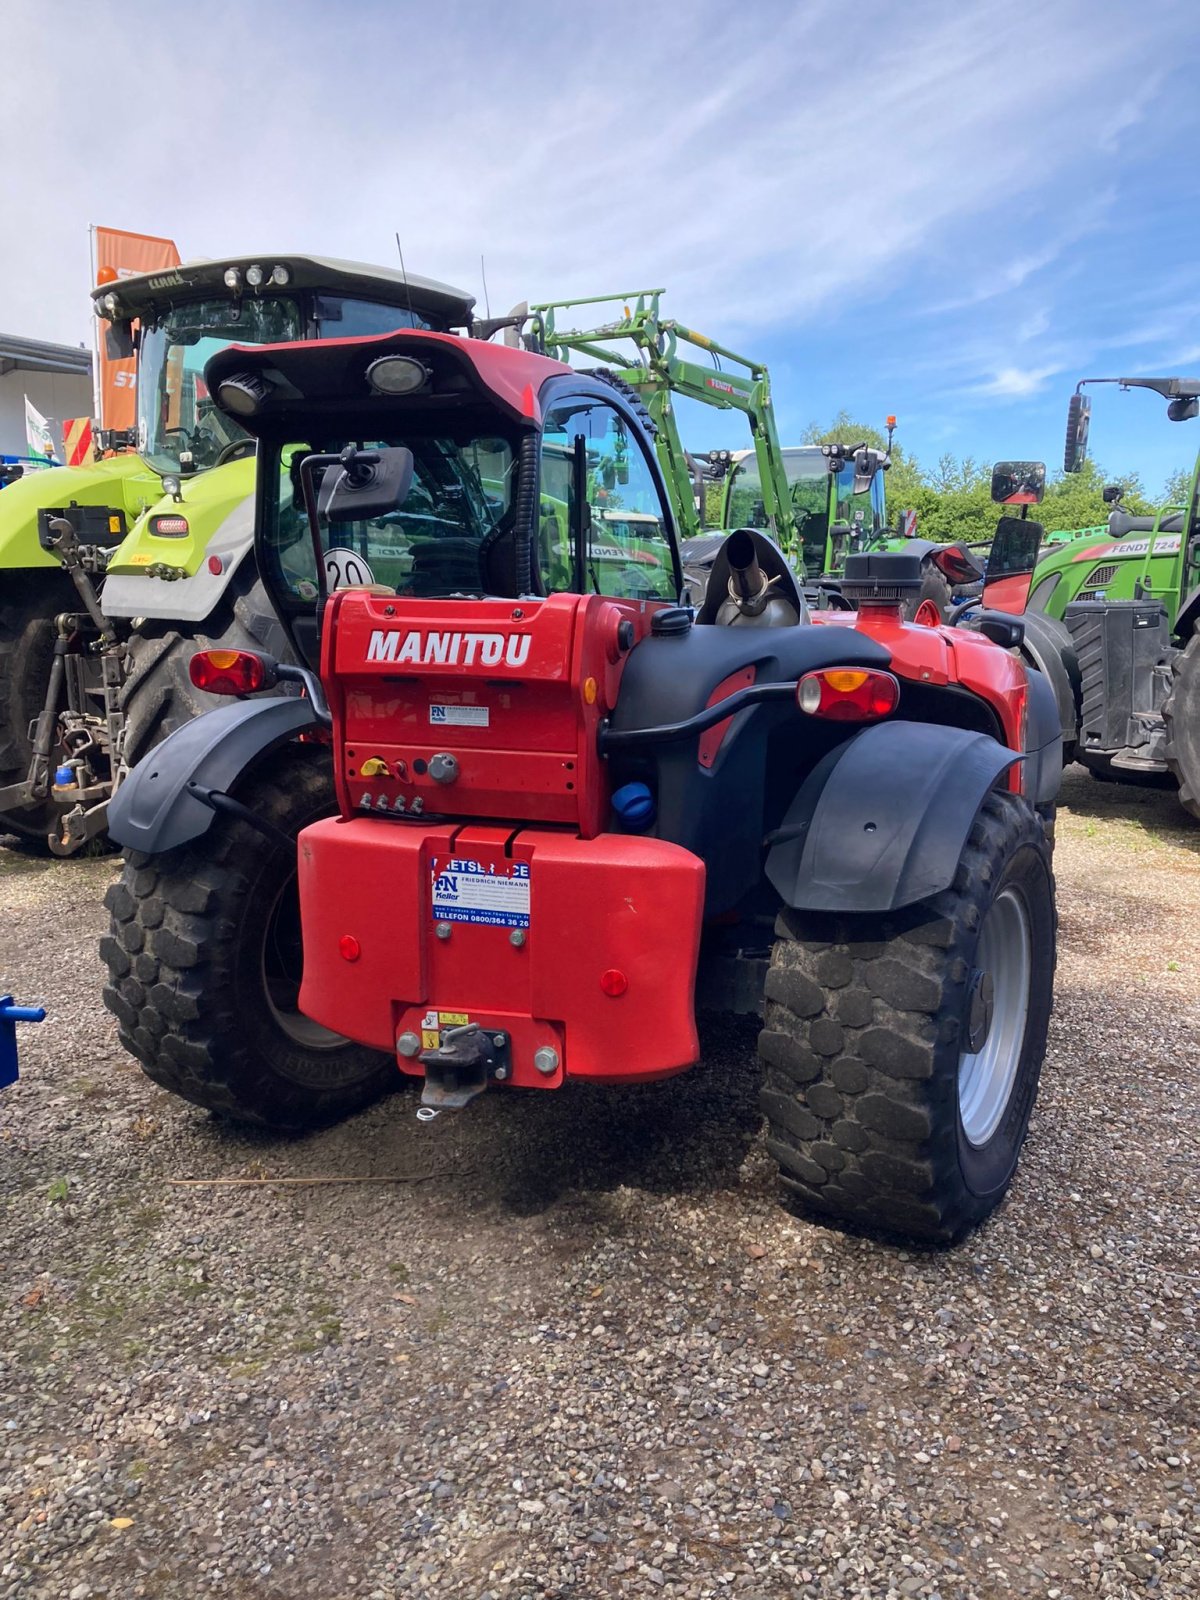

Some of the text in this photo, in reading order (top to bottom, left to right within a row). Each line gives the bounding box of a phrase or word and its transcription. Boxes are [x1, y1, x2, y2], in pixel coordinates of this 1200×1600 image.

[1112, 543, 1150, 553] FENDT
[1154, 541, 1175, 550] 724
[327, 560, 364, 592] 20
[366, 630, 532, 667] MANITOU
[461, 877, 528, 888] FRIEDRICH NIEMANN
[435, 892, 459, 900] Keller
[435, 911, 469, 921] TELEFON
[470, 915, 505, 925] 0800/364
